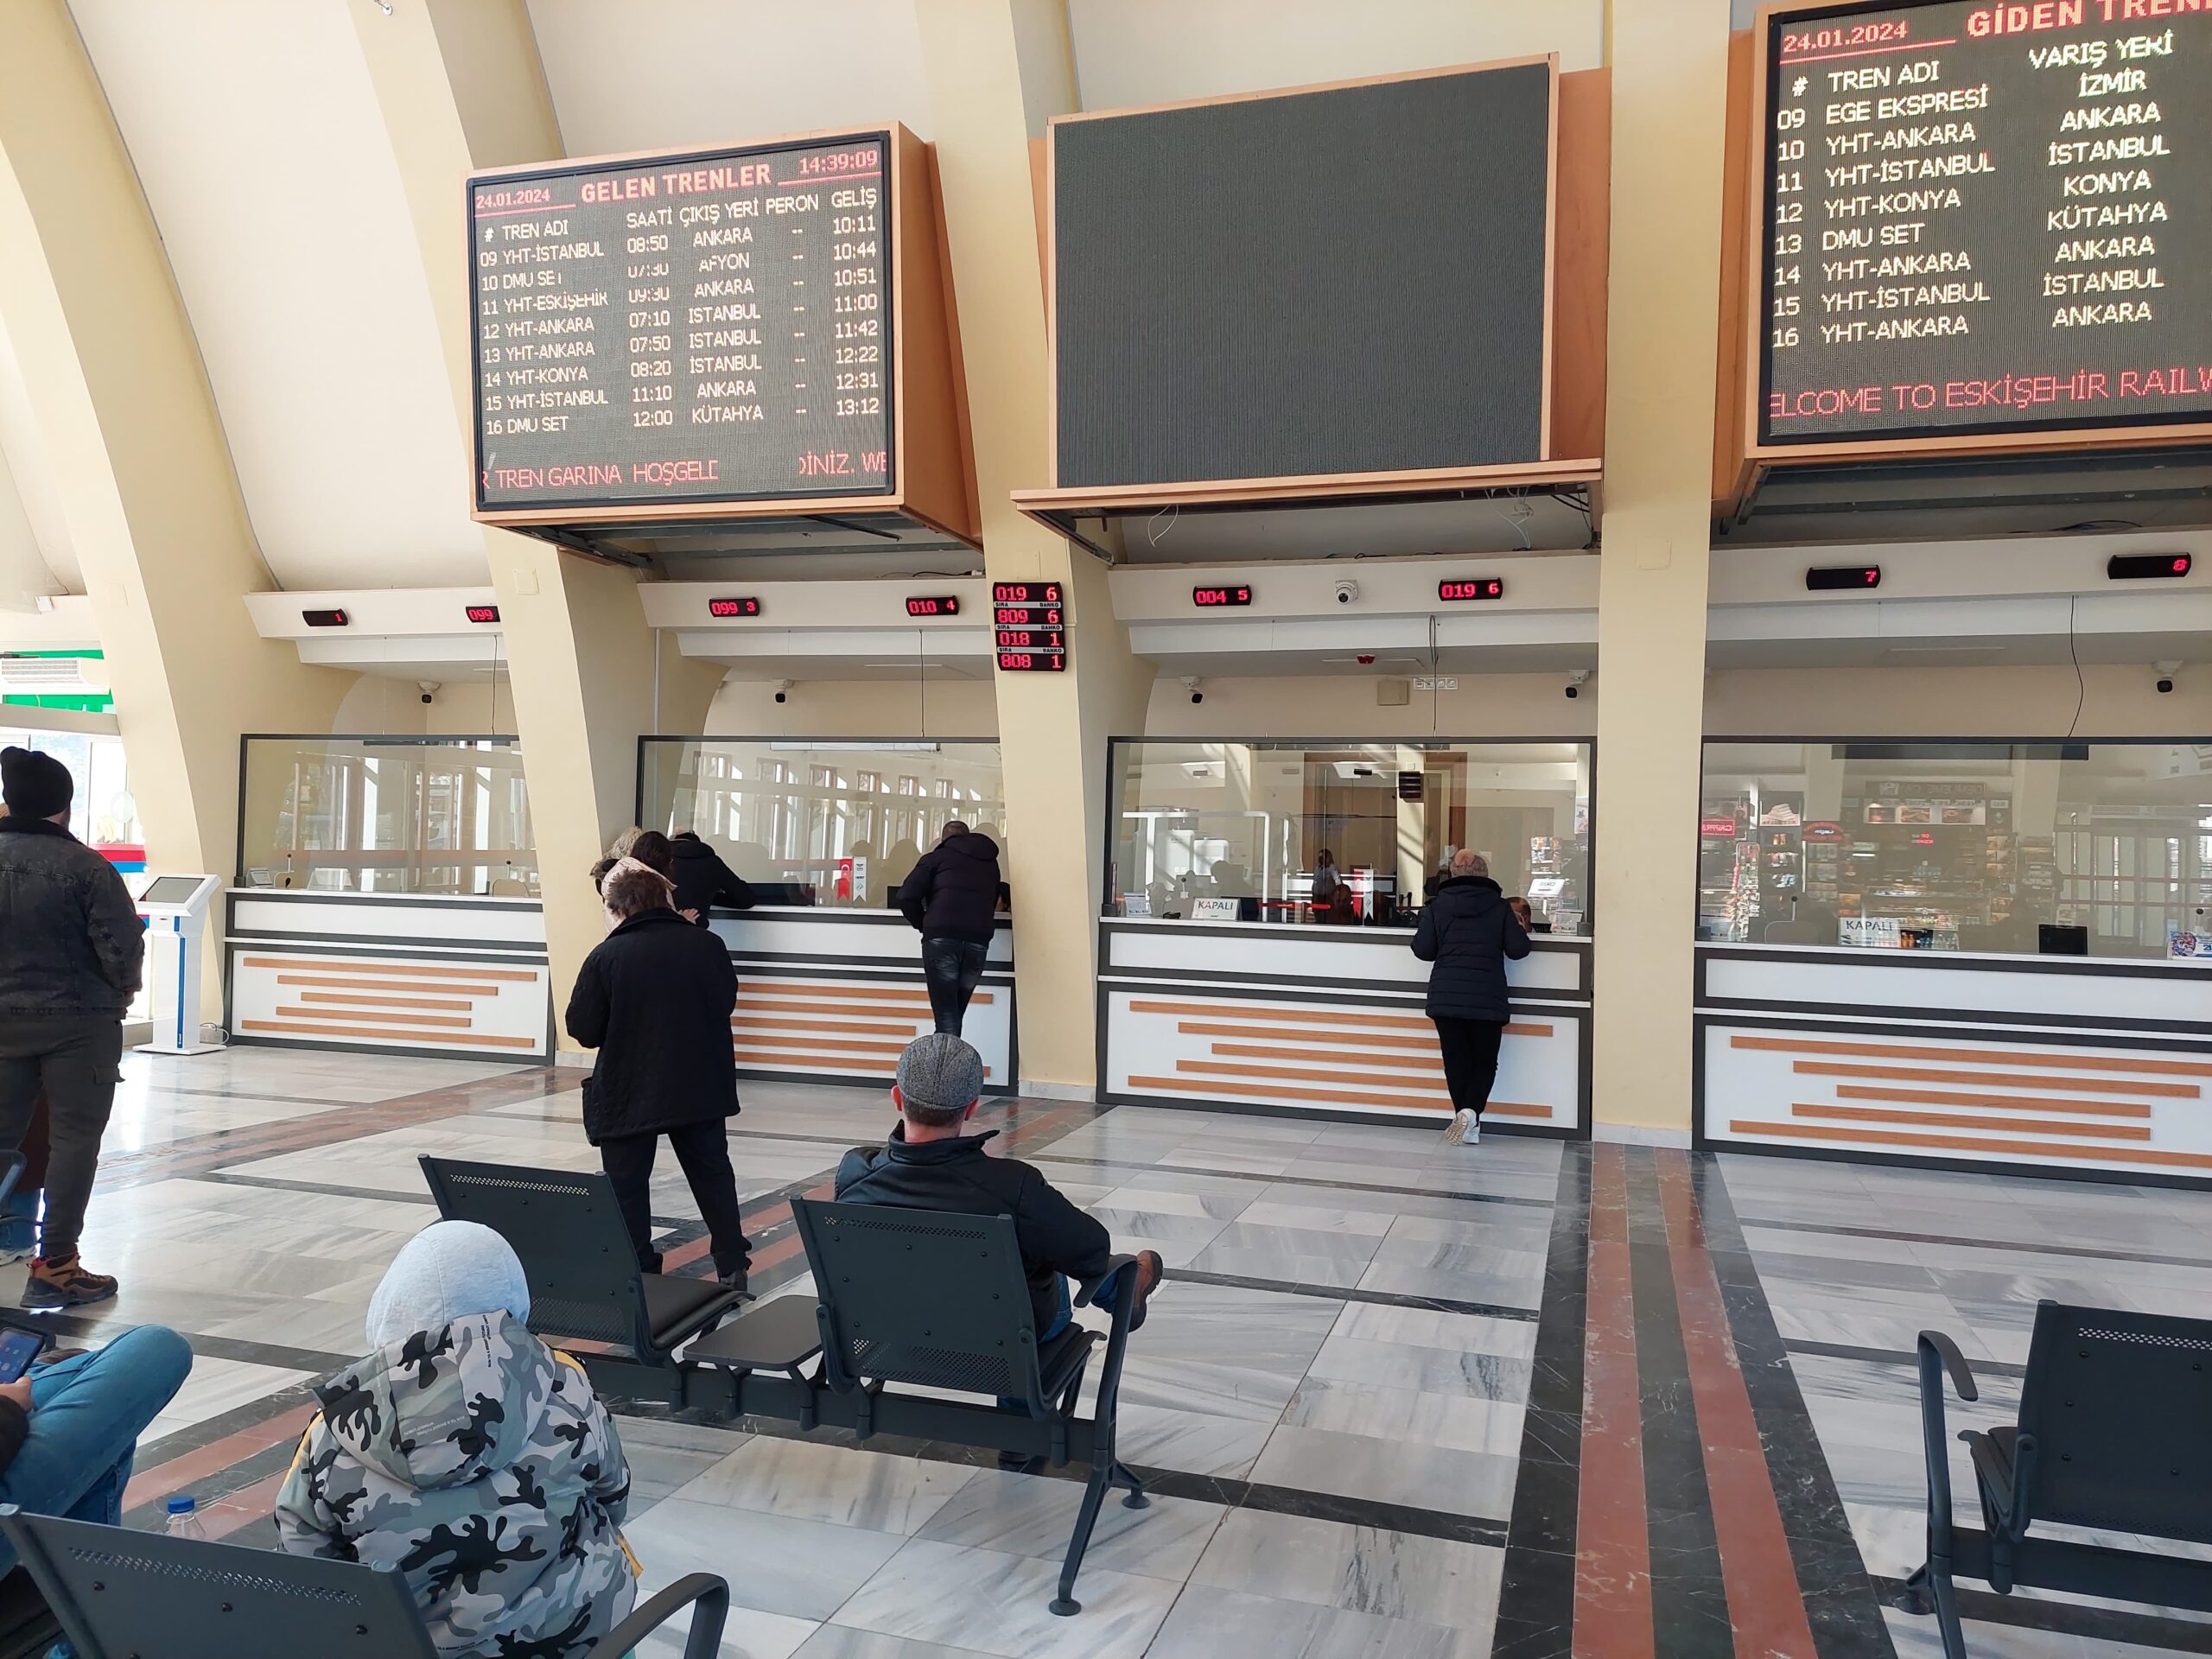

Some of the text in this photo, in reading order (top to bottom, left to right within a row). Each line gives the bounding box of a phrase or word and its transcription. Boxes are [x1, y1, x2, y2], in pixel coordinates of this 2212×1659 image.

[1783, 21, 1908, 53] 24.01.2024
[1967, 0, 2082, 37] GİDEN
[1827, 67, 1891, 92] TREN
[1897, 60, 1940, 85] ADI
[2029, 41, 2107, 69] VARIŞ
[1777, 67, 2147, 130] 09 EGE EKSPRESİ İZMİR
[1778, 101, 2161, 161] 10 YHT-ANKARA ANKARA
[799, 149, 878, 175] 14:39:09
[1777, 135, 2171, 193] 11 YHT-İSTANBUL İSTANBUL
[476, 188, 550, 209] 24.01.2024
[581, 163, 772, 203] GELEN TRENLER
[1777, 169, 2152, 224] 12 YHT-KONYA KONYA
[502, 221, 539, 241] TREN
[543, 219, 569, 237] ADI
[626, 206, 672, 229] SAATİ
[680, 204, 720, 227] ÇIKIŞ
[725, 197, 759, 219] YERİ
[766, 194, 819, 215] PERON
[831, 186, 877, 209] GELİŞ
[1776, 200, 2168, 255] 13 DMU SET KÜTAHYA
[480, 251, 497, 267] 09
[503, 241, 604, 265] YHT-İSTANBUL
[626, 235, 668, 254] 08:50
[693, 226, 753, 247] ANKARA
[833, 214, 876, 235] 10:11
[482, 276, 498, 291] 10
[503, 272, 534, 289] DMU
[833, 241, 877, 261] 10:44
[1775, 235, 2155, 286] 14 YHT-ANKARA ANKARA
[483, 300, 499, 315] 11
[694, 278, 754, 298] ANKARA
[834, 268, 877, 287] 10:51
[1774, 268, 2164, 317] 15 YHT-İSTANBUL İSTANBUL
[484, 325, 499, 340] 12
[505, 316, 594, 338] YHT-ANKARA
[629, 310, 671, 328] 07:10
[835, 294, 877, 313] 11:00
[1772, 302, 2152, 348] 16 YHT-ANKARA ANKARA
[485, 348, 500, 364] 13
[505, 341, 595, 361] YHT-ANKARA
[630, 335, 671, 353] 07:50
[835, 320, 878, 339] 11:42
[485, 372, 500, 387] 14
[506, 365, 588, 385] YHT-KONYA
[631, 360, 671, 378] 08:20
[836, 346, 878, 364] 12:22
[486, 397, 501, 411] 15
[507, 390, 608, 410] YHT-İSTANBUL
[632, 385, 672, 403] 11:10
[697, 379, 756, 398] ANKARA
[836, 372, 879, 390] 12:31
[1892, 383, 1936, 411] TO
[1945, 368, 2109, 409] ESKİŞEHİR
[486, 420, 502, 435] 16
[507, 417, 537, 434] DMU
[542, 416, 569, 432] SET
[633, 410, 672, 428] 12:00
[692, 404, 764, 424] KÜTAHYA
[836, 397, 879, 416] 13:12
[495, 467, 543, 488] TREN
[548, 464, 622, 487] GARINA
[996, 587, 1057, 601] 019 6
[1441, 582, 1498, 598] 019 6
[1866, 570, 1876, 582] 7
[711, 601, 756, 615] 099 3
[909, 601, 956, 613] 010 4
[1196, 590, 1248, 603] 004 5
[998, 609, 1058, 624] 809 6
[1000, 632, 1059, 646] 018 1
[1001, 654, 1061, 668] 808 1
[1198, 901, 1233, 910] KAPALI
[1847, 920, 1892, 931] KAPALI
